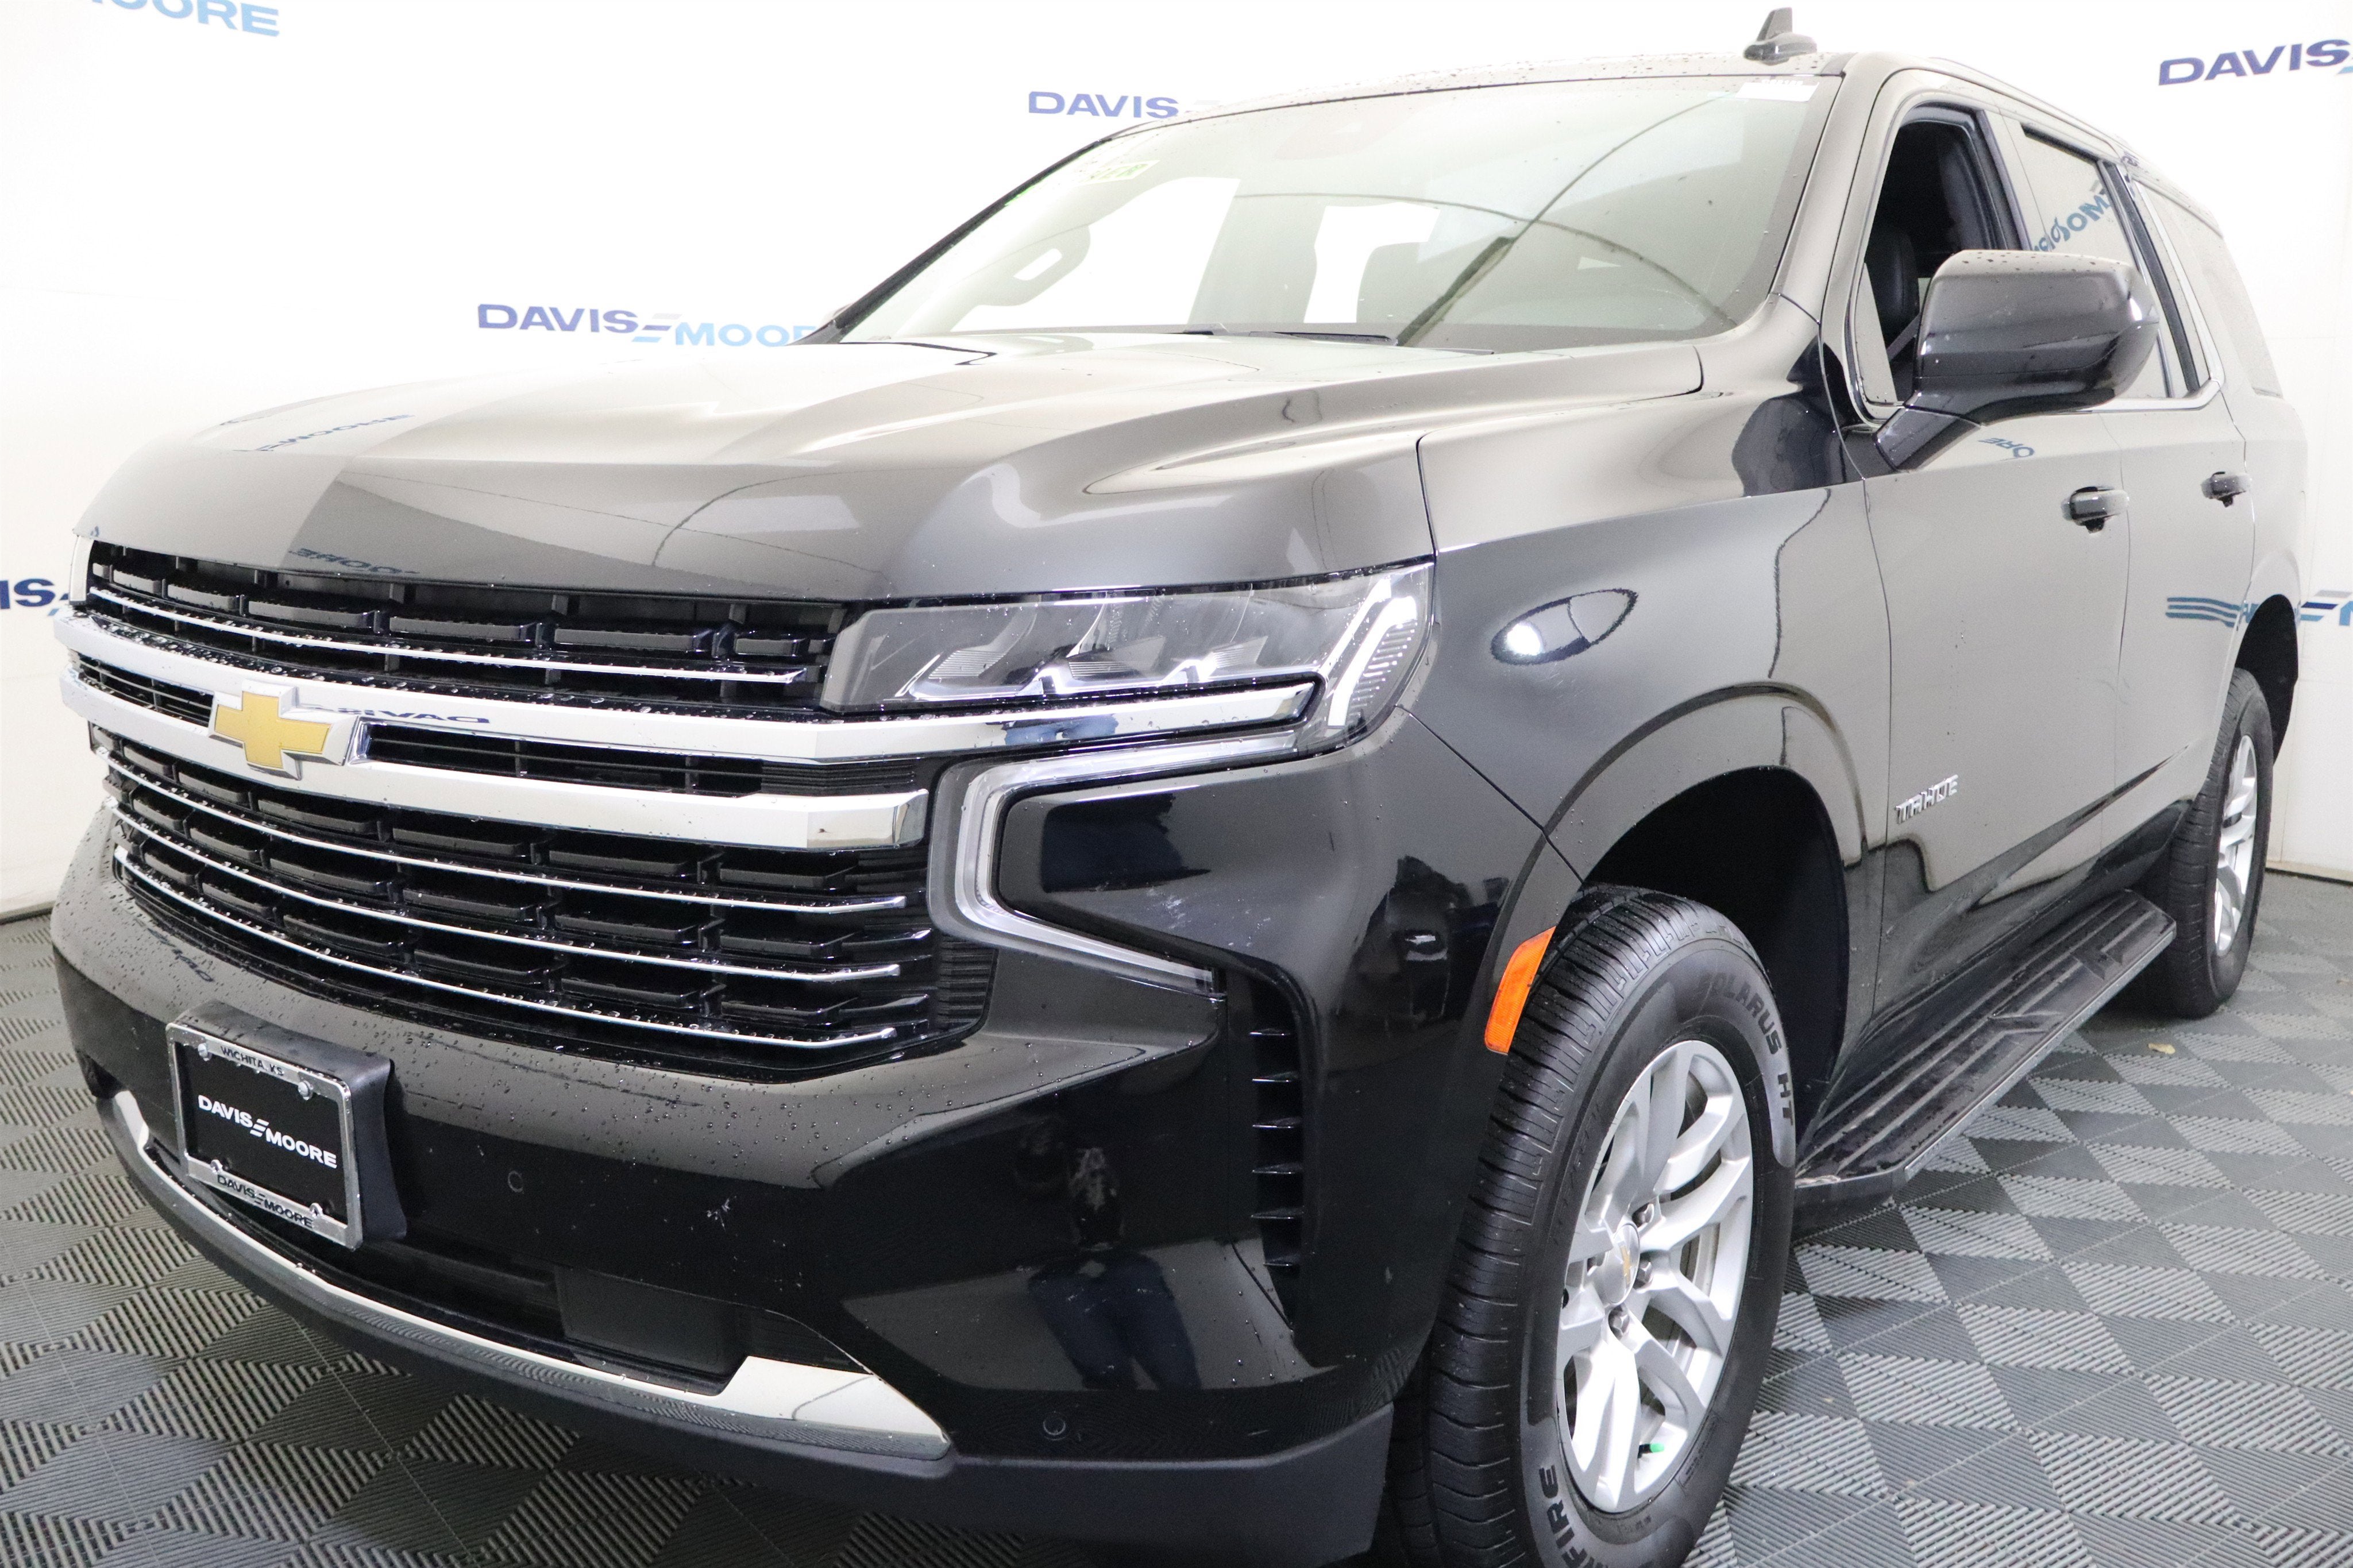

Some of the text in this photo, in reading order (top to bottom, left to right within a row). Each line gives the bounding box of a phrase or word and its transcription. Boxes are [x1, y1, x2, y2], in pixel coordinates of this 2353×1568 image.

[75, 0, 280, 37] ORE
[2158, 39, 2352, 86] DAVIS
[1028, 91, 1179, 119] DAVIS
[478, 303, 639, 334] DAVIS
[1894, 774, 1958, 825] TAHOE
[1778, 1072, 1793, 1126] HT
[198, 1095, 338, 1169] DAVIS MOORE
[217, 1174, 314, 1229] DAVIS MOORE
